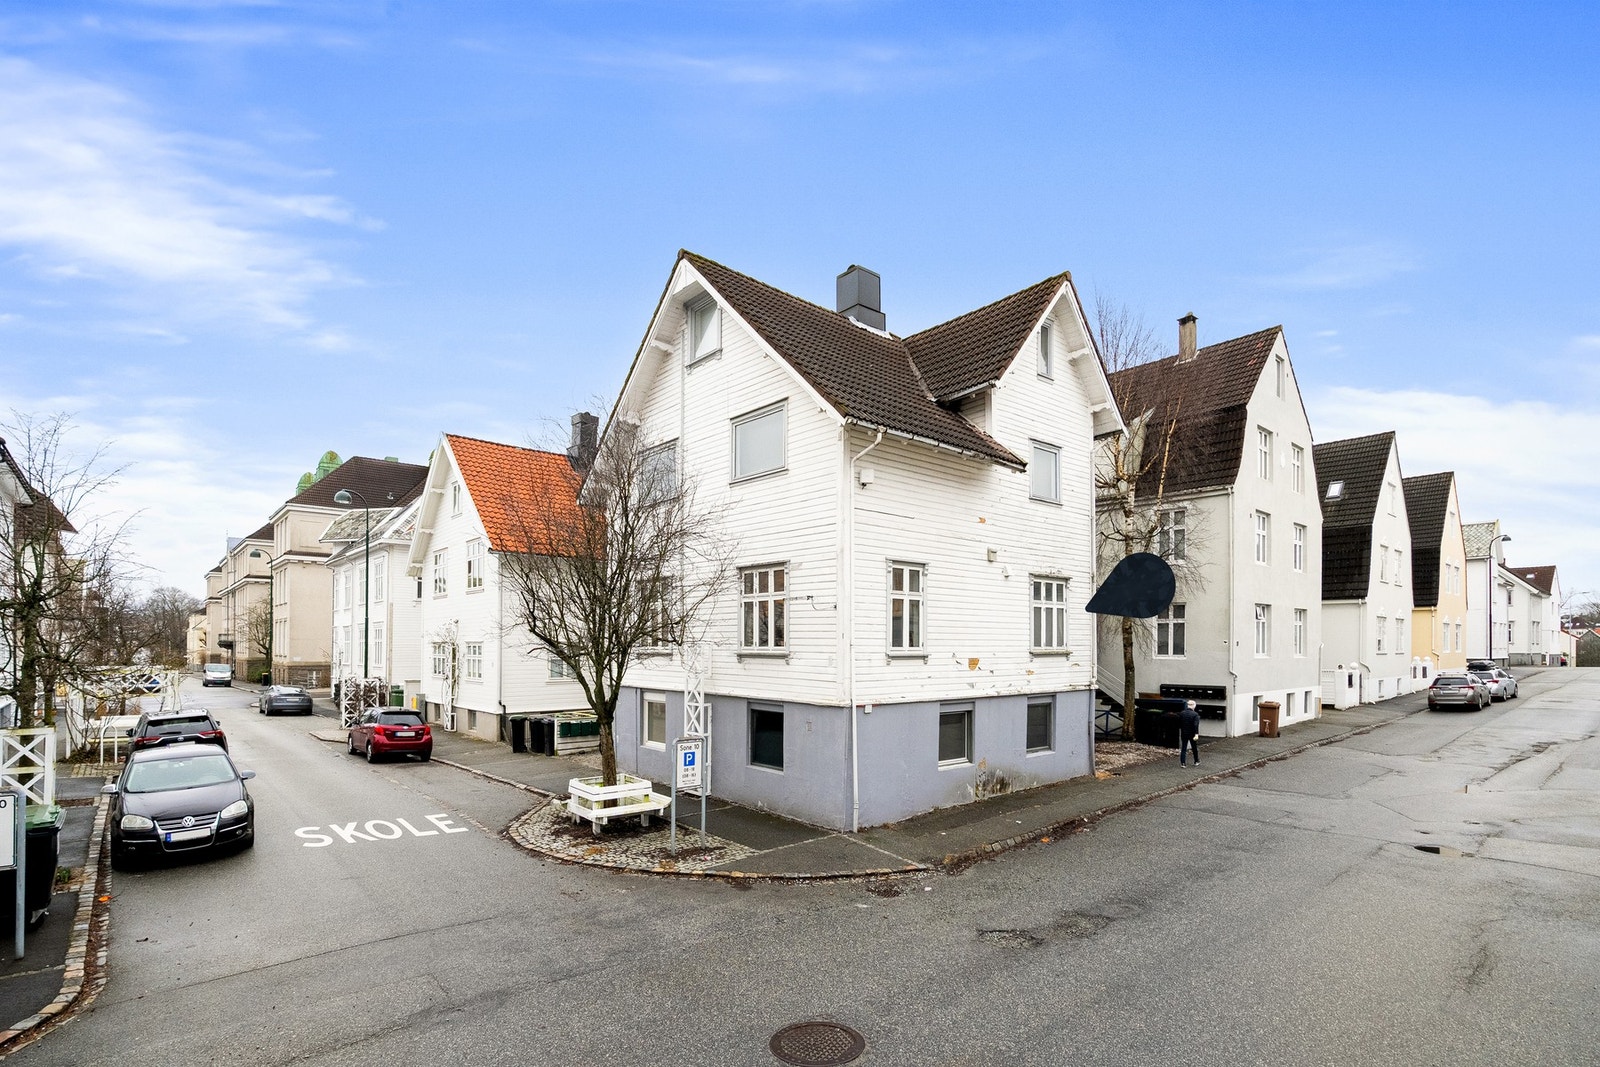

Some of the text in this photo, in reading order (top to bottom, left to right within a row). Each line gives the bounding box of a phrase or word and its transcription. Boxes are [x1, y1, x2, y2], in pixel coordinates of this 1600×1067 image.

[686, 754, 693, 765] P
[181, 816, 195, 828] VW
[294, 813, 469, 847] SKOLE
